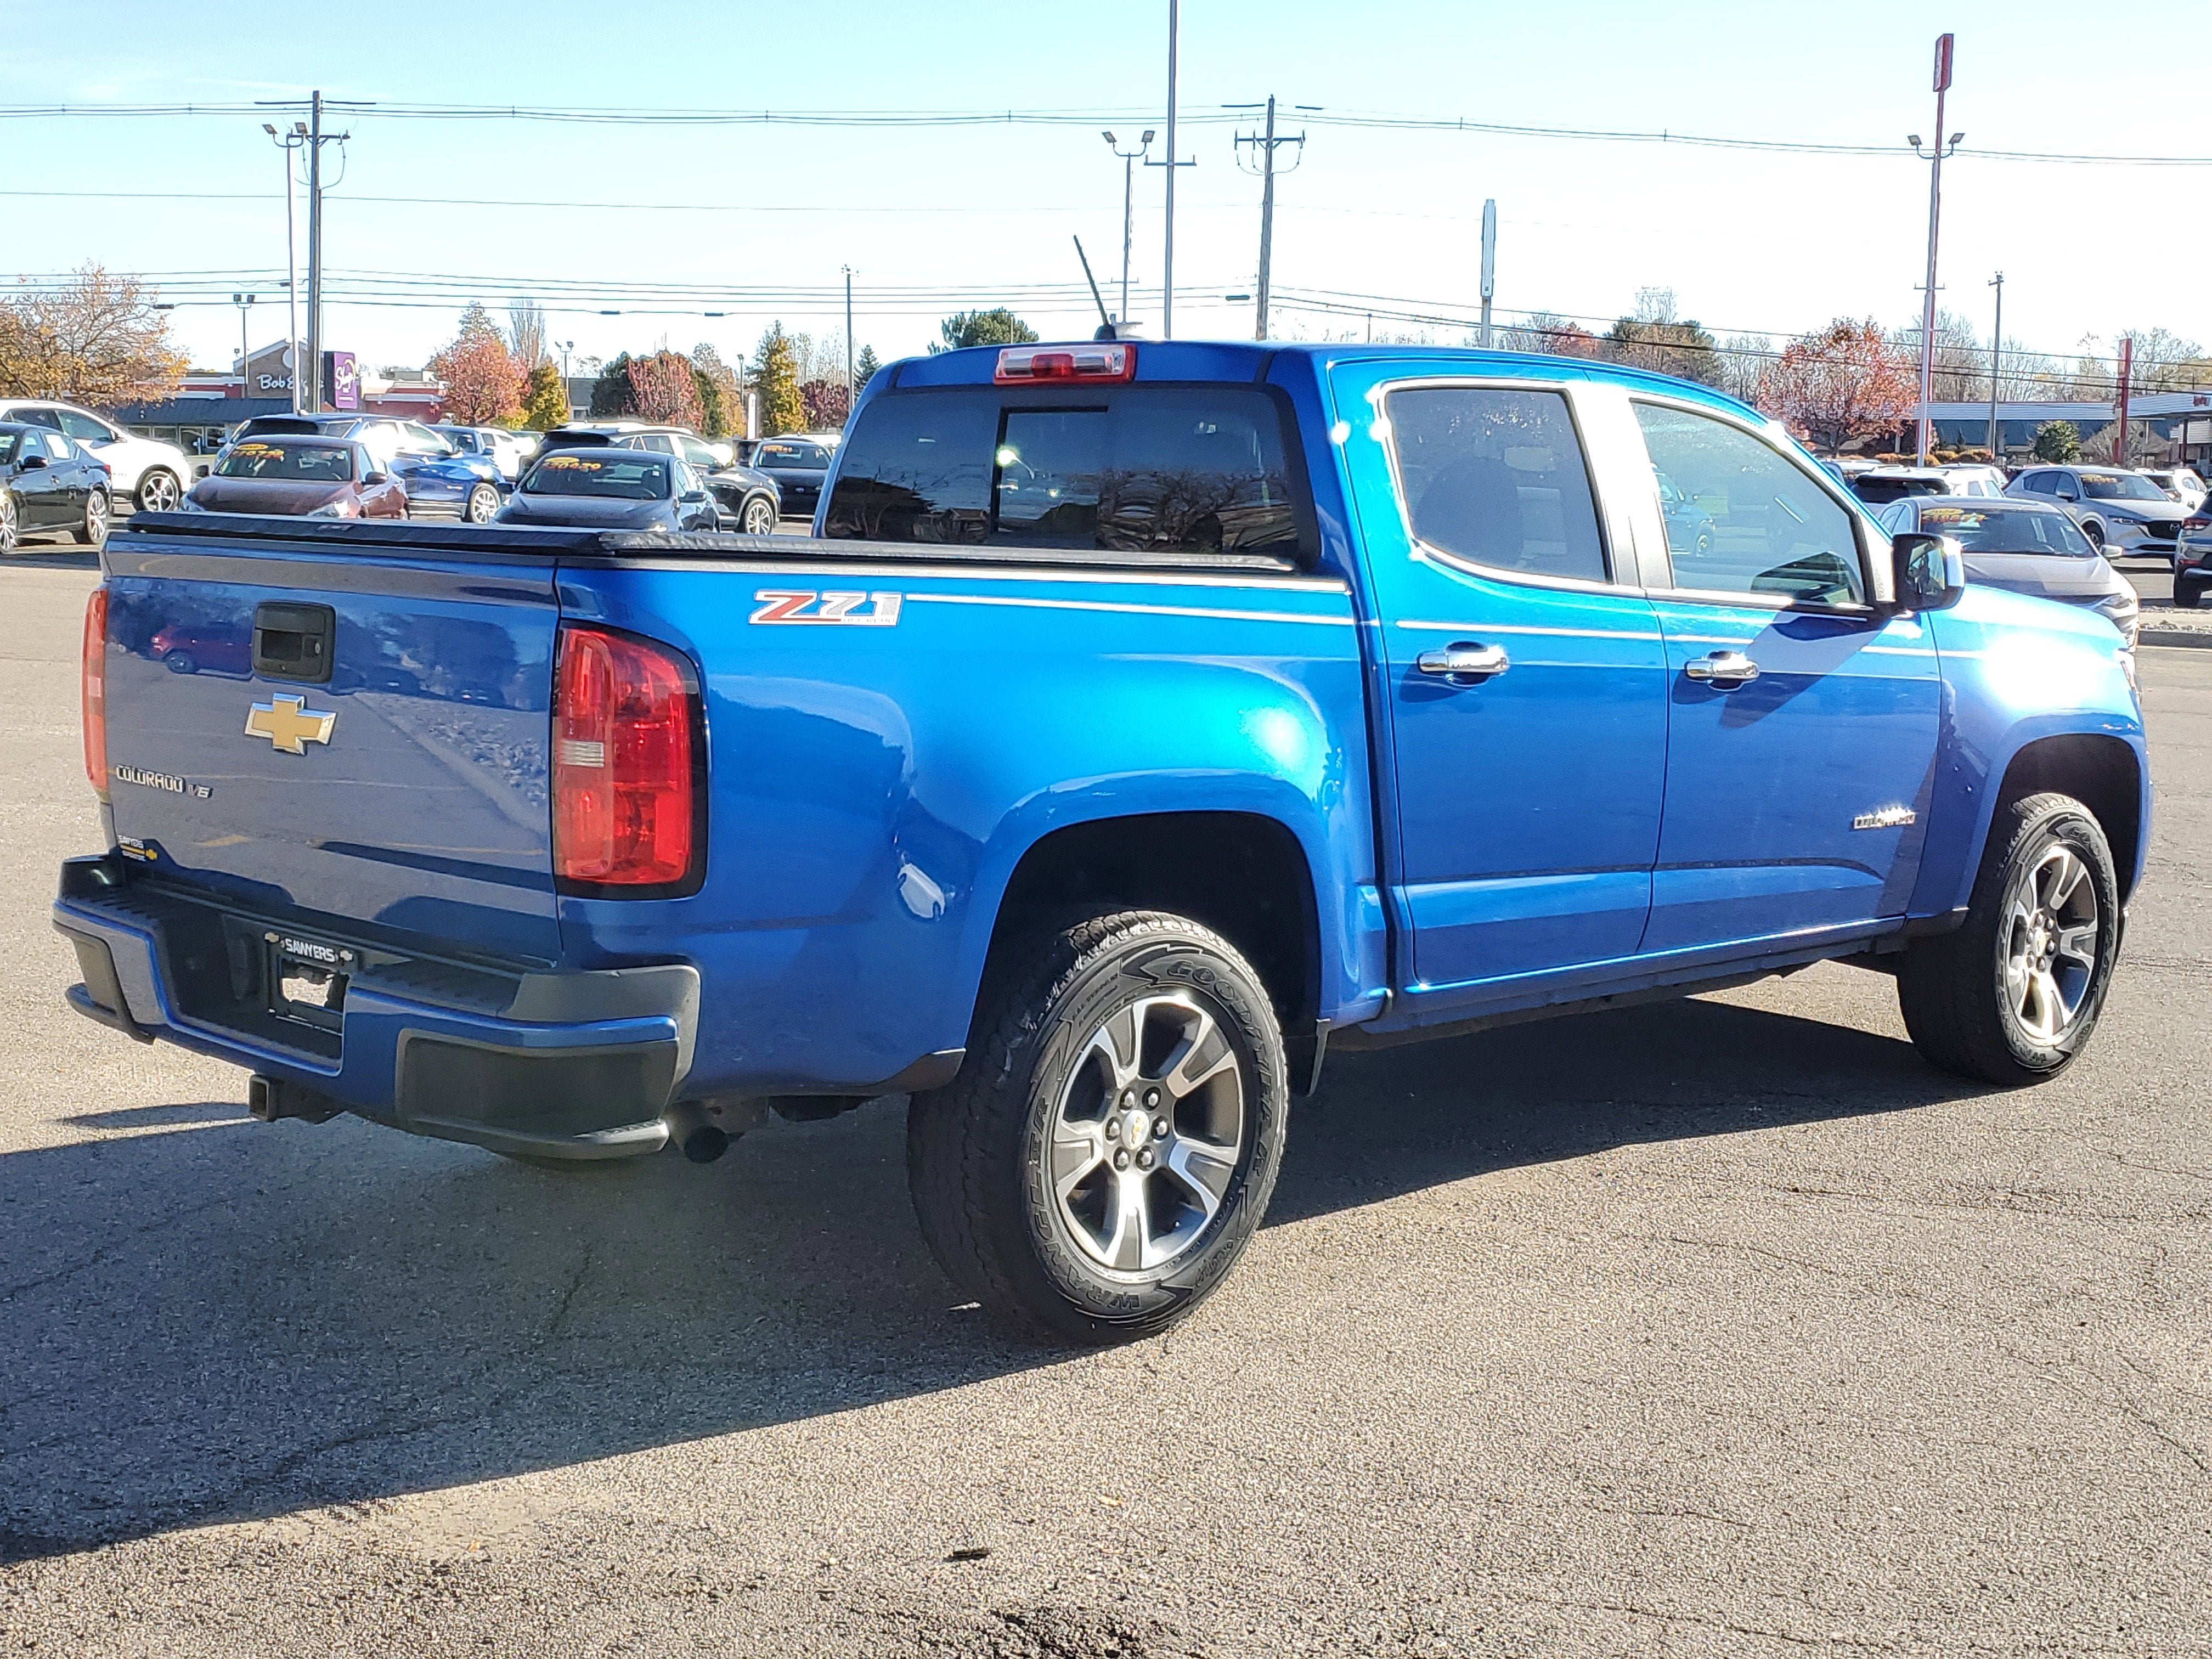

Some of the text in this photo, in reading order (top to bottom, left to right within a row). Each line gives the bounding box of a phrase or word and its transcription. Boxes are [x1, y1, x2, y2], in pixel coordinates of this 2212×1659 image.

[256, 374, 286, 390] Bob
[748, 590, 902, 626] Z71
[115, 764, 212, 799] COLORADO V6
[285, 938, 336, 963] SAWYERS
[1167, 960, 1272, 1177] GOODYEAR
[1029, 1096, 1142, 1310] WRANGLER
